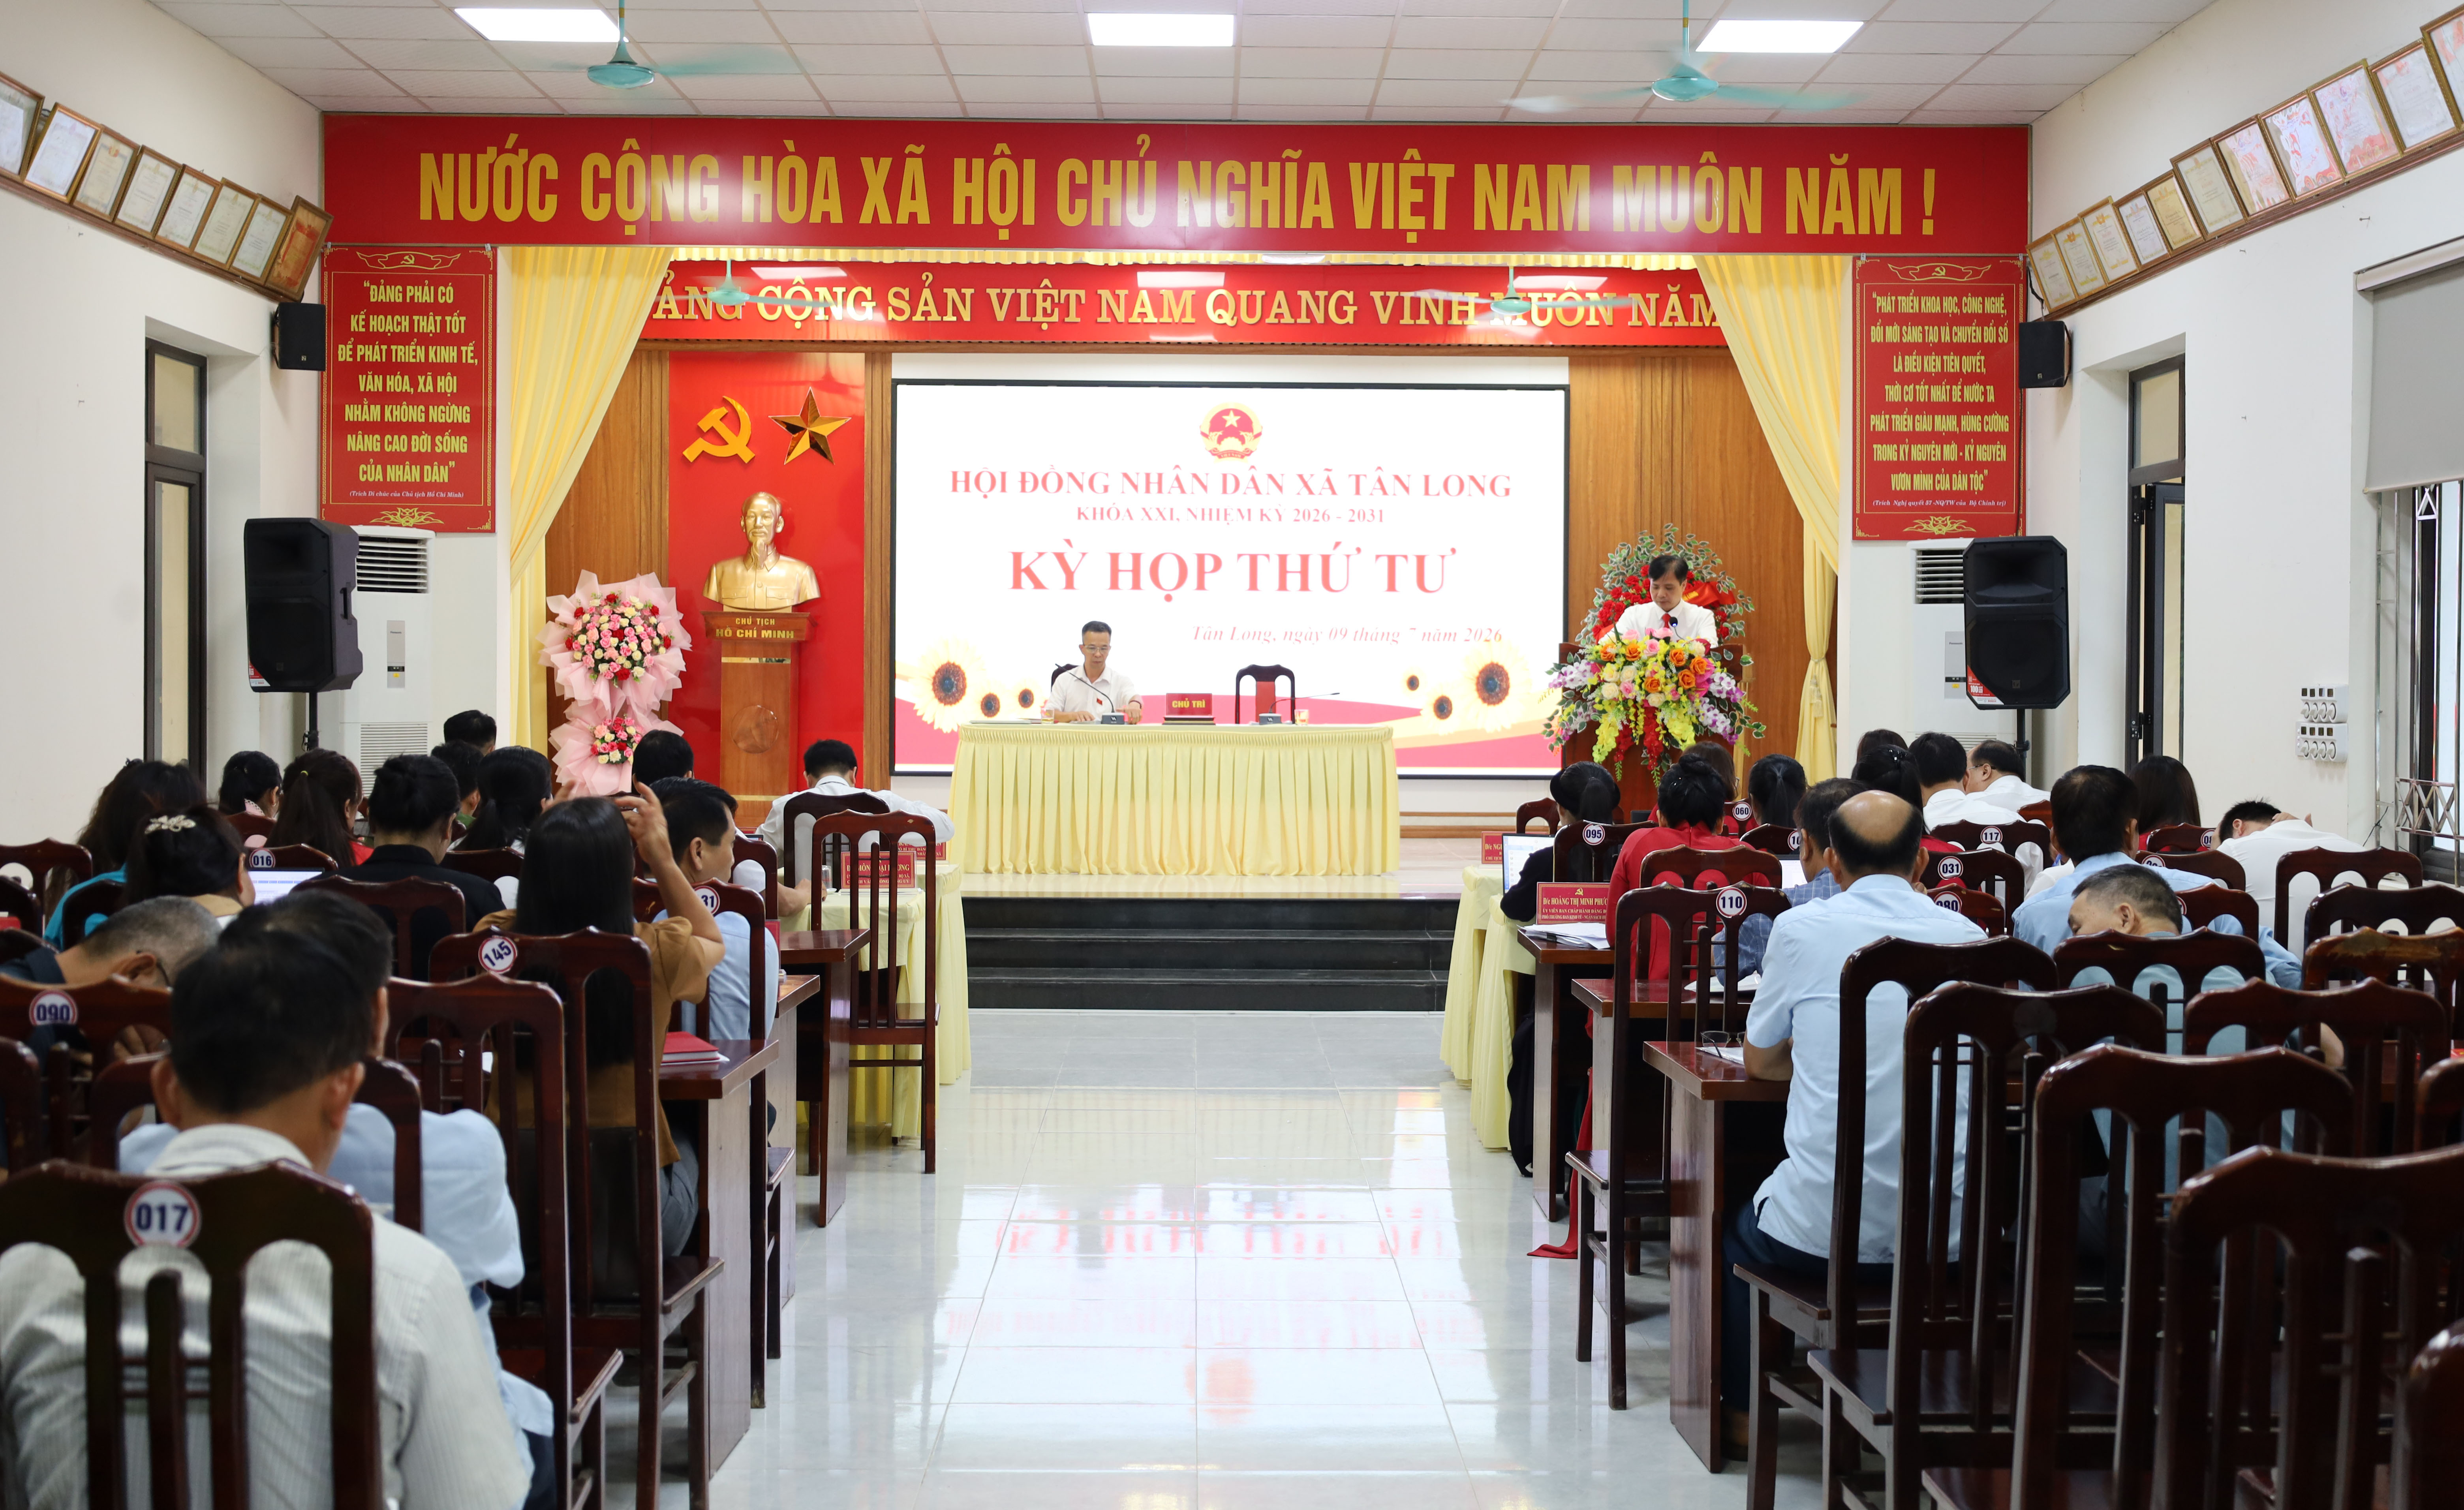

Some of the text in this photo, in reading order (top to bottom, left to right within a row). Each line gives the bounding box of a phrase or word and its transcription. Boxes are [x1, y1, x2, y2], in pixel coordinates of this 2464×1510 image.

[420, 134, 1934, 243] NƯỚC CỘNG HÒA XÃ HỘI CHỦ NGHĨA VIỆT NAM MUÔN NĂM !
[364, 280, 453, 303] “ĐẢNG PHẢI CÓ
[757, 271, 1720, 330] CỘNG SẢN VIỆT NAM QUANG VINH NĂM
[1872, 289, 2006, 317] “PHÁT TRIỂN KHOA HỌC, CÔNG NGHỆ,
[351, 310, 466, 336] KẾ HOẠCH THẬT TỐT
[1871, 319, 2008, 346] ĐỔI MỚI SÁNG TẠO VÀ CHUYỂN ĐỔI SỐ
[338, 338, 478, 365] ĐỂ PHÁT TRIỂN KINH TẾ,
[1894, 350, 1985, 376] LÀ ĐIỀU KIỆN TIÊN QUYẾT,
[359, 372, 456, 396] VĂN HÓA, XÃ HỘI
[1885, 378, 1994, 402] THỜI CƠ TỐT NHẤT ĐỂ NƯỚC TA
[345, 398, 470, 423] NHẰM KHÔNG NGỪNG
[1871, 408, 2009, 435] PHÁT TRIỂN GIÀU MẠNH, HÙNG CƯỜNG
[347, 430, 468, 453] NÂNG CAO ĐỜI SỐNG
[1873, 438, 2006, 461] TRONG KỶ NGUYÊN MỚI KỶ NGUYÊN
[359, 458, 455, 483] CỦA NHÂN DÂN”
[950, 464, 1511, 499] HỘI ĐỒNG NHÂN DÂN XÃ TÂN LONG
[1891, 468, 1988, 494] VƯƠN MÌNH CỦA DÂN TỘC”
[1077, 503, 1383, 525] KHÓA XXI, NHIỆM KỲ 2026 2031
[1008, 539, 1457, 603] KỲ HỌP THỨ TƯ
[716, 627, 794, 639] HỒ CHÍ MINH
[736, 616, 775, 626] CHỦ TỊCH
[1193, 626, 1502, 644] Tân Long, ngày 09 tháng năm 2026
[1172, 698, 1190, 708] CHỦ
[1586, 829, 1602, 839] 095
[1984, 832, 1999, 840] 117
[253, 855, 271, 866] 016
[1942, 864, 1959, 873] 031
[1551, 896, 1569, 905] HOÀNG
[1570, 898, 1579, 907] THỊ
[1720, 896, 1742, 909] 110
[483, 941, 512, 967] 145
[37, 1004, 70, 1022] 090
[134, 1202, 190, 1234] 017
